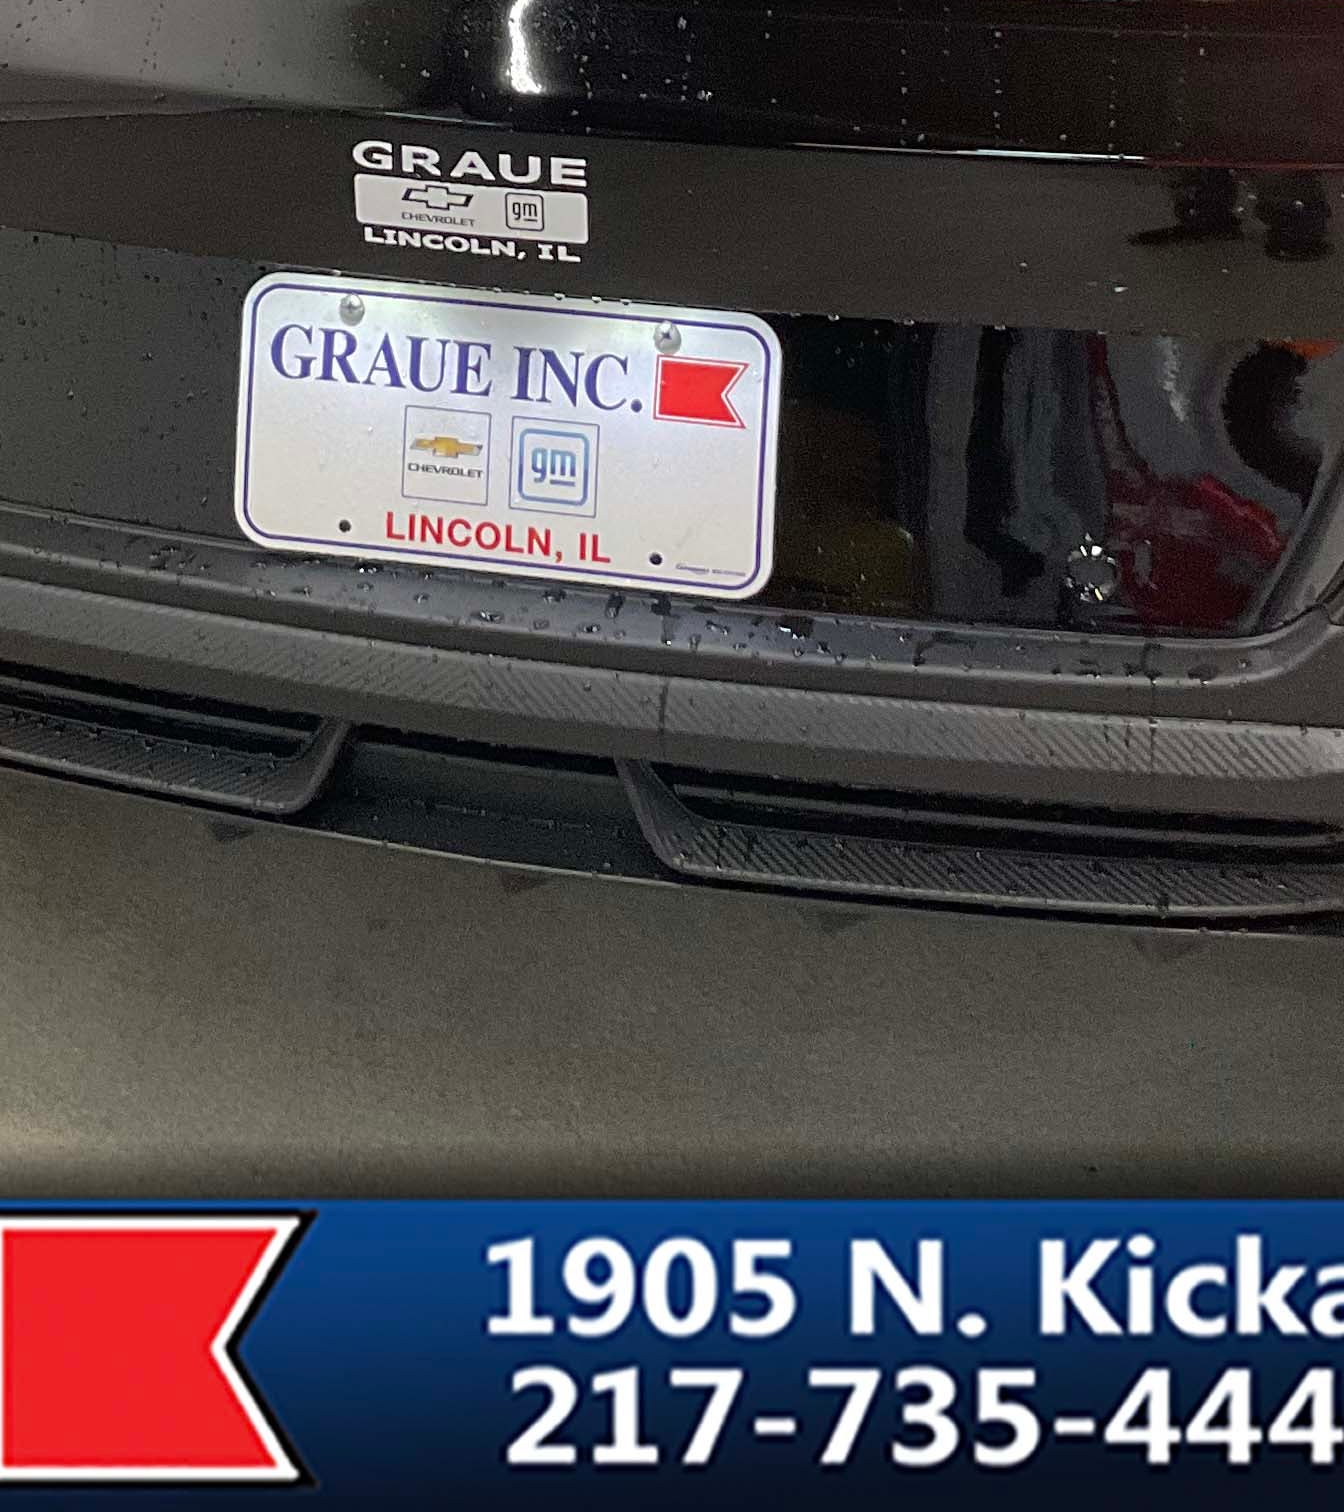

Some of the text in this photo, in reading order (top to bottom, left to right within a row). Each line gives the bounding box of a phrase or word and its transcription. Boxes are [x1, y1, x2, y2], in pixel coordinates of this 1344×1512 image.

[352, 140, 587, 187] GRAUE
[401, 211, 475, 227] CHEVROLET
[511, 201, 539, 222] gm
[363, 226, 581, 262] LINCOLN, IL
[270, 324, 643, 413] GRAUE INC.
[407, 461, 483, 479] CHEVROLET
[530, 446, 577, 482] gm
[385, 511, 611, 564] LINCOLN, IL
